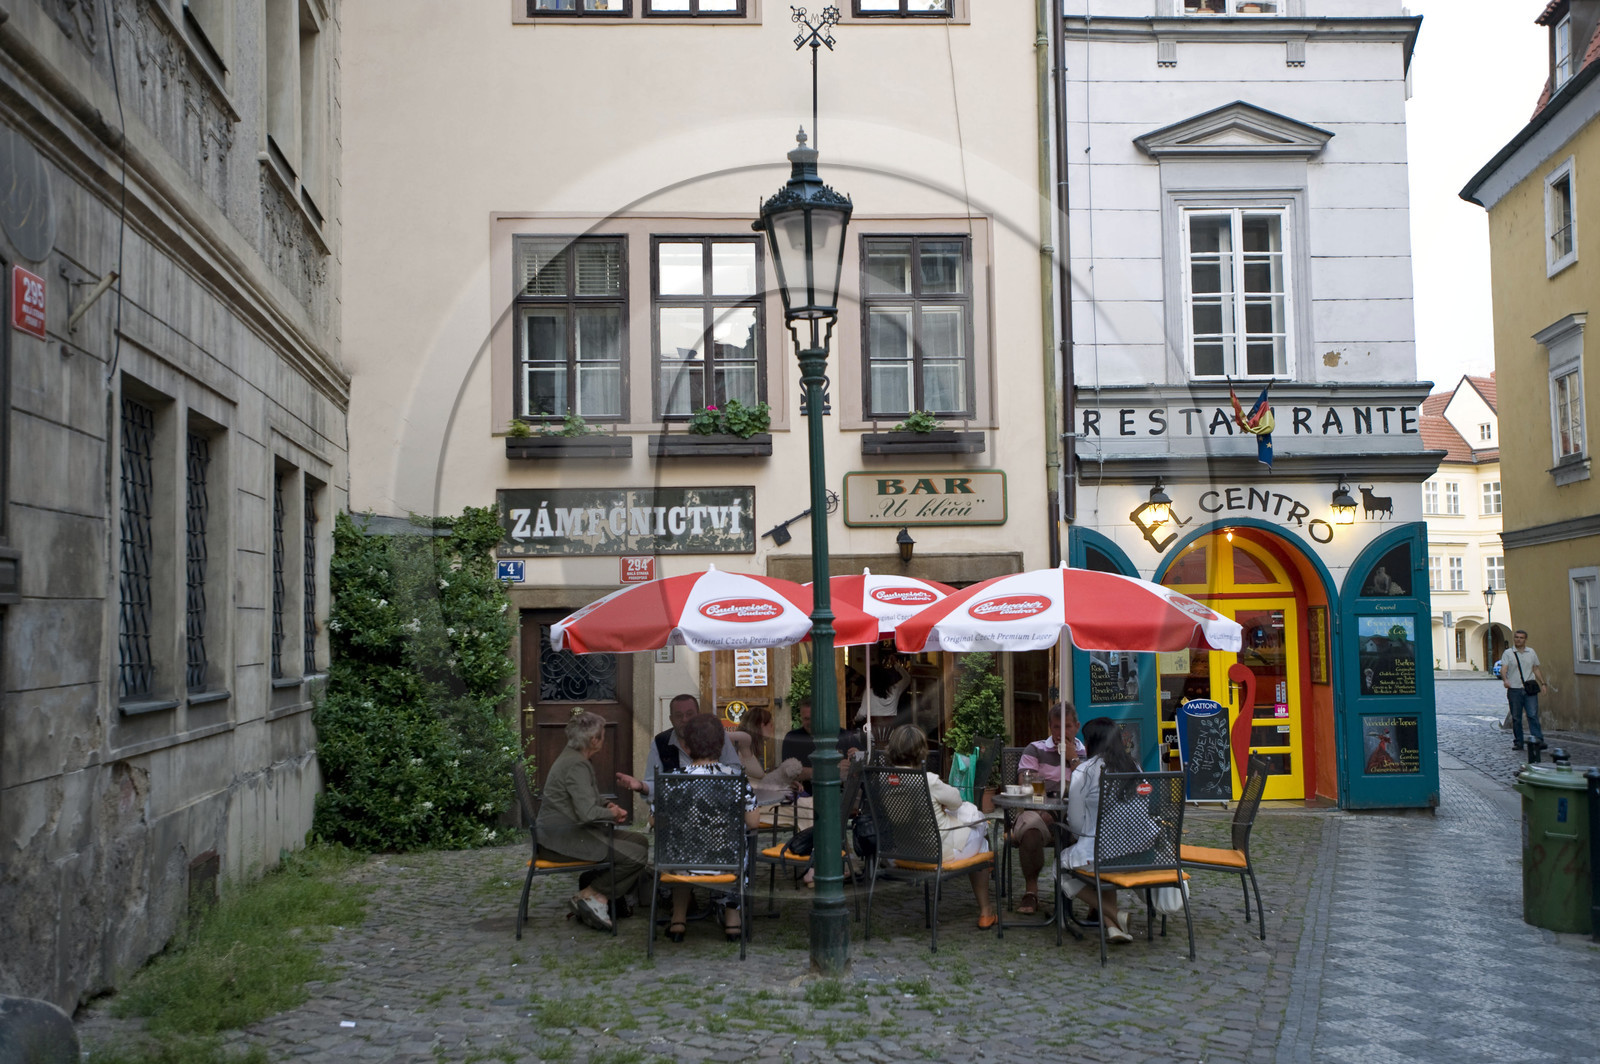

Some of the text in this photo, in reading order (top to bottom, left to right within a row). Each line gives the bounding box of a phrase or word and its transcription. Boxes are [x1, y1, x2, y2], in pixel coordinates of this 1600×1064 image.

[23, 277, 45, 308] 295
[1083, 406, 1418, 435] RESTARANTE
[876, 478, 976, 495] BAR
[1199, 487, 1334, 544] CENTRO
[507, 562, 515, 575] 4
[628, 559, 648, 571] 294
[706, 604, 777, 616] Budweiser
[974, 601, 1044, 614] Budweiser
[725, 637, 748, 645] Czech
[750, 636, 783, 644] Premium
[944, 635, 974, 643] Original
[1187, 702, 1218, 710] MATTONI
[1190, 731, 1209, 774] GARDEN
